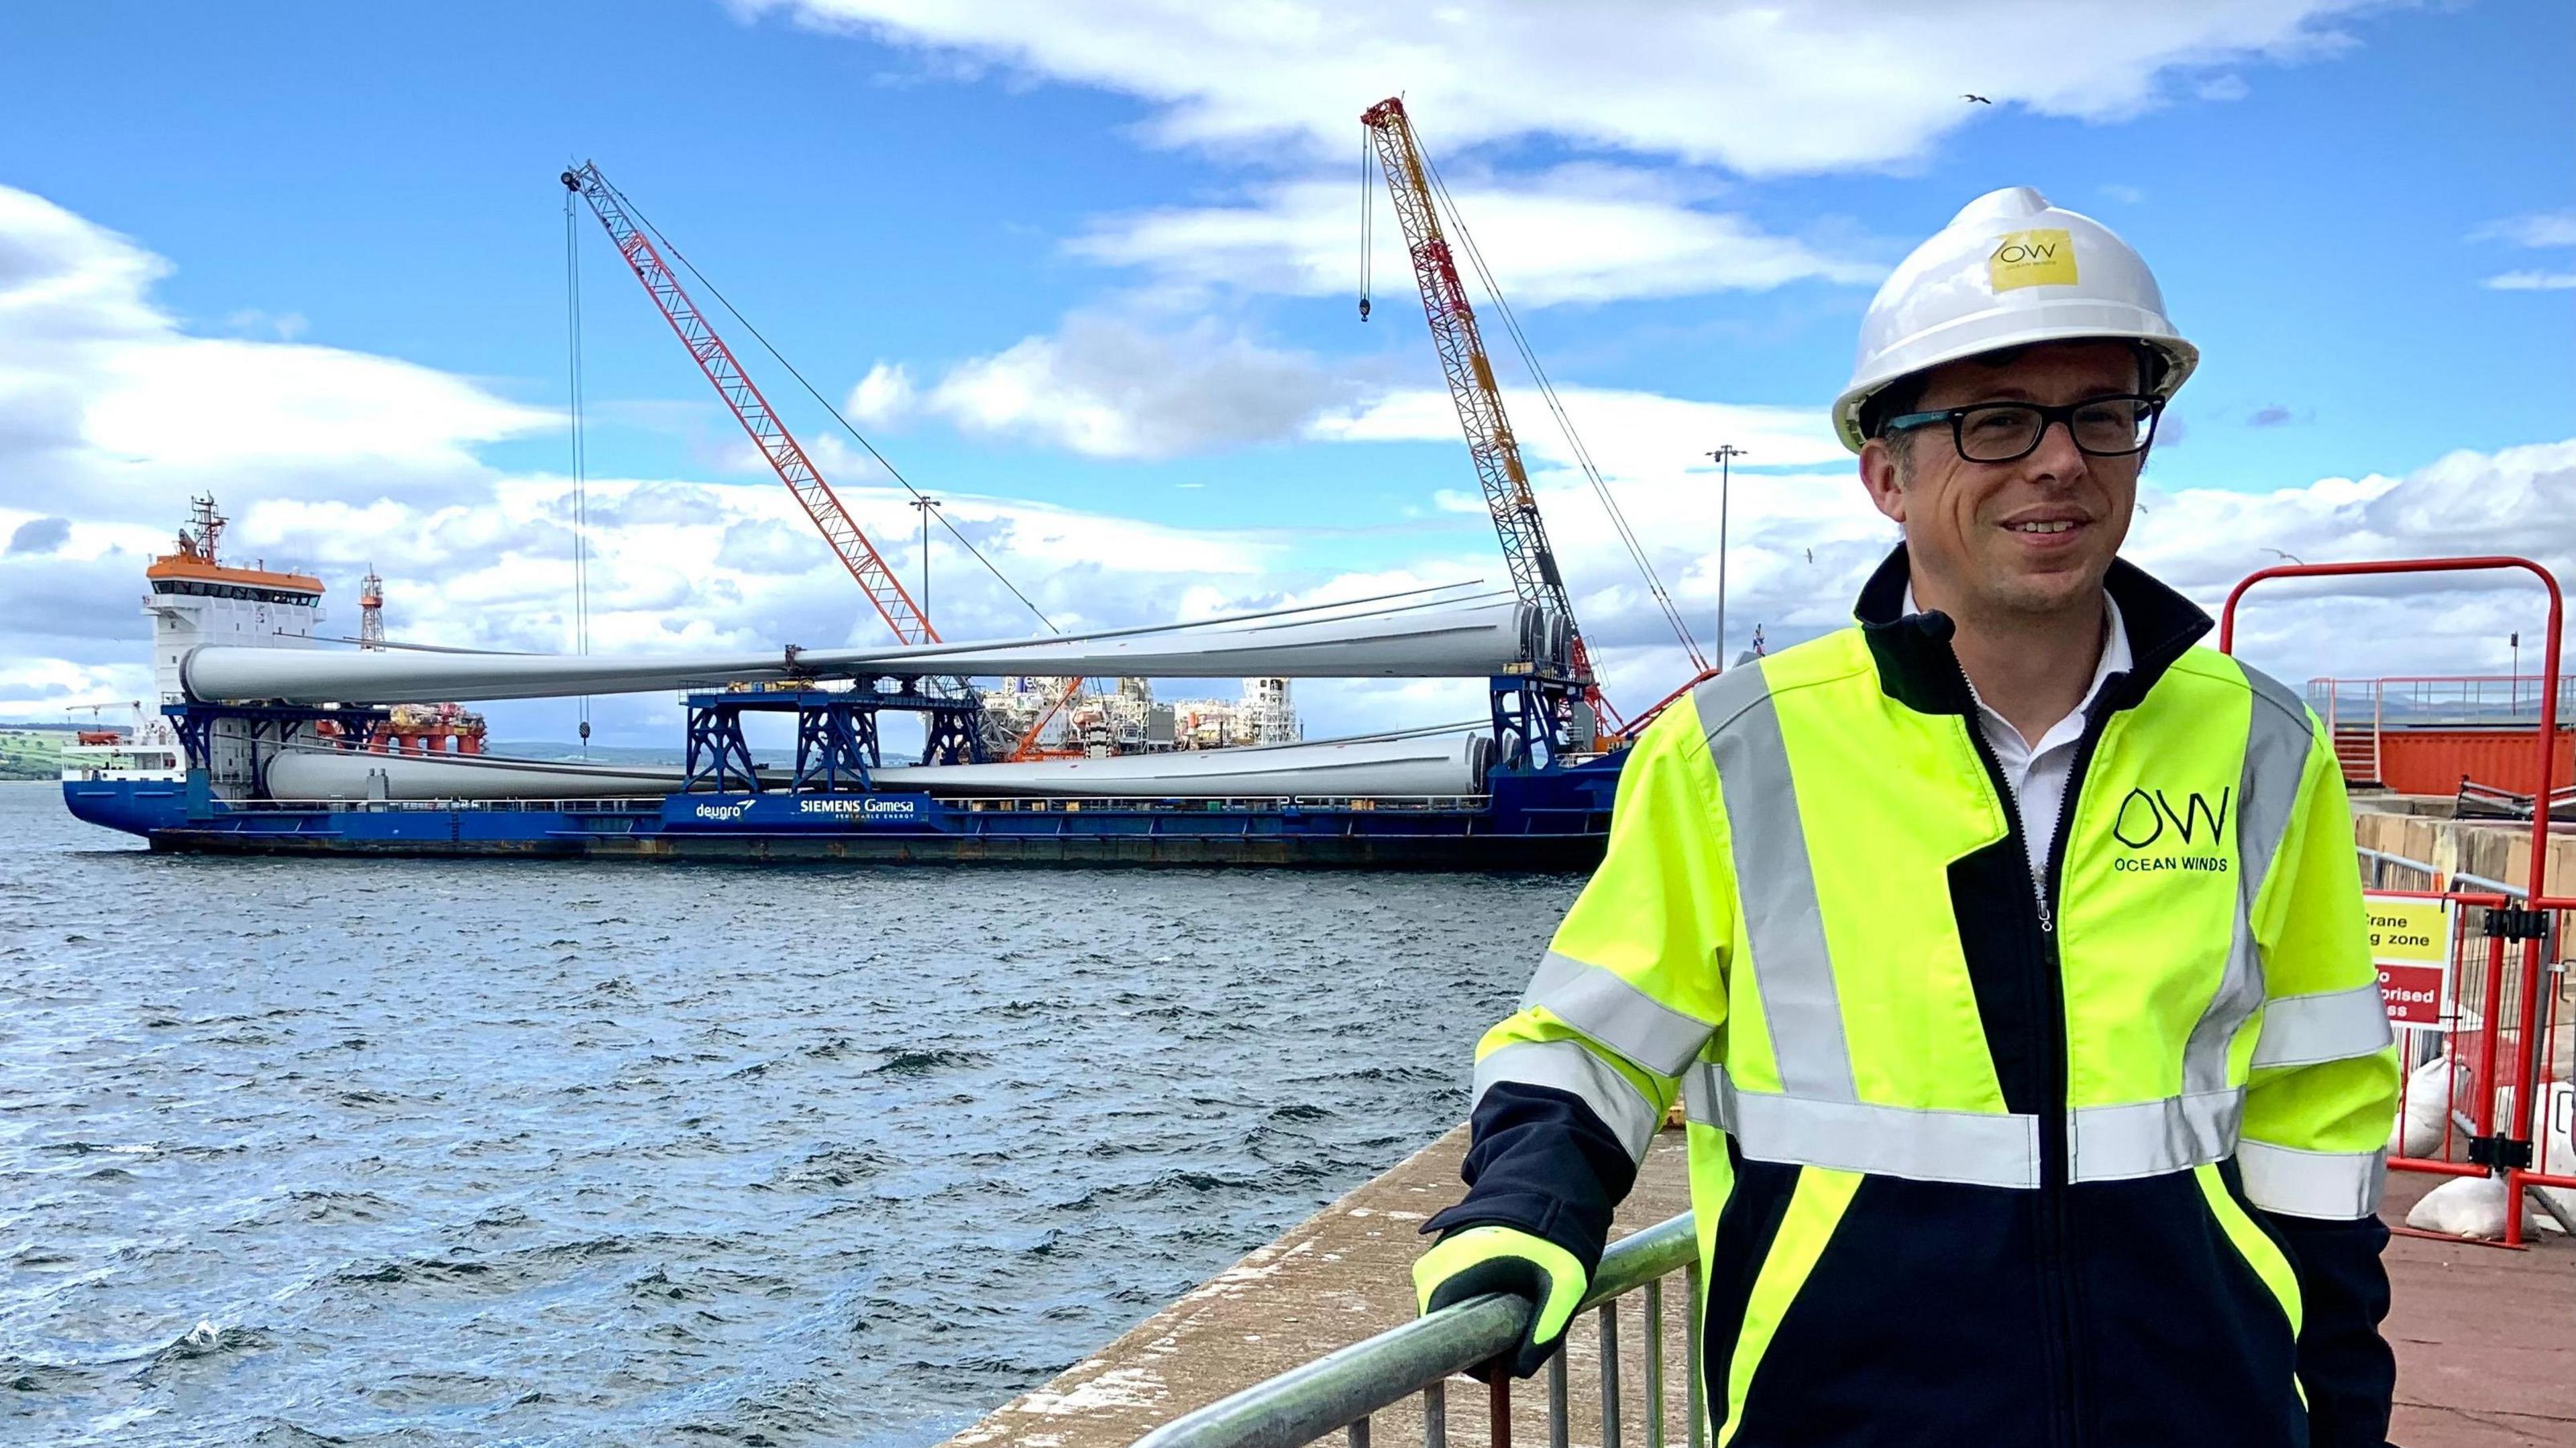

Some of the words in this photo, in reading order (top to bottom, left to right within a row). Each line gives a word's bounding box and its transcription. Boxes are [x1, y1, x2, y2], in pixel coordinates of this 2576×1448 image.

[2000, 243, 2056, 263] OW
[696, 803, 741, 820] deugro
[800, 800, 861, 812] SIEMENS
[864, 798, 914, 812] Gamesa
[2113, 786, 2230, 848] OW
[2114, 857, 2176, 872] OCEAN
[2182, 856, 2228, 872] WINDS
[2366, 913, 2407, 928] rane
[2388, 934, 2430, 946] zone
[2381, 987, 2434, 1003] orised
